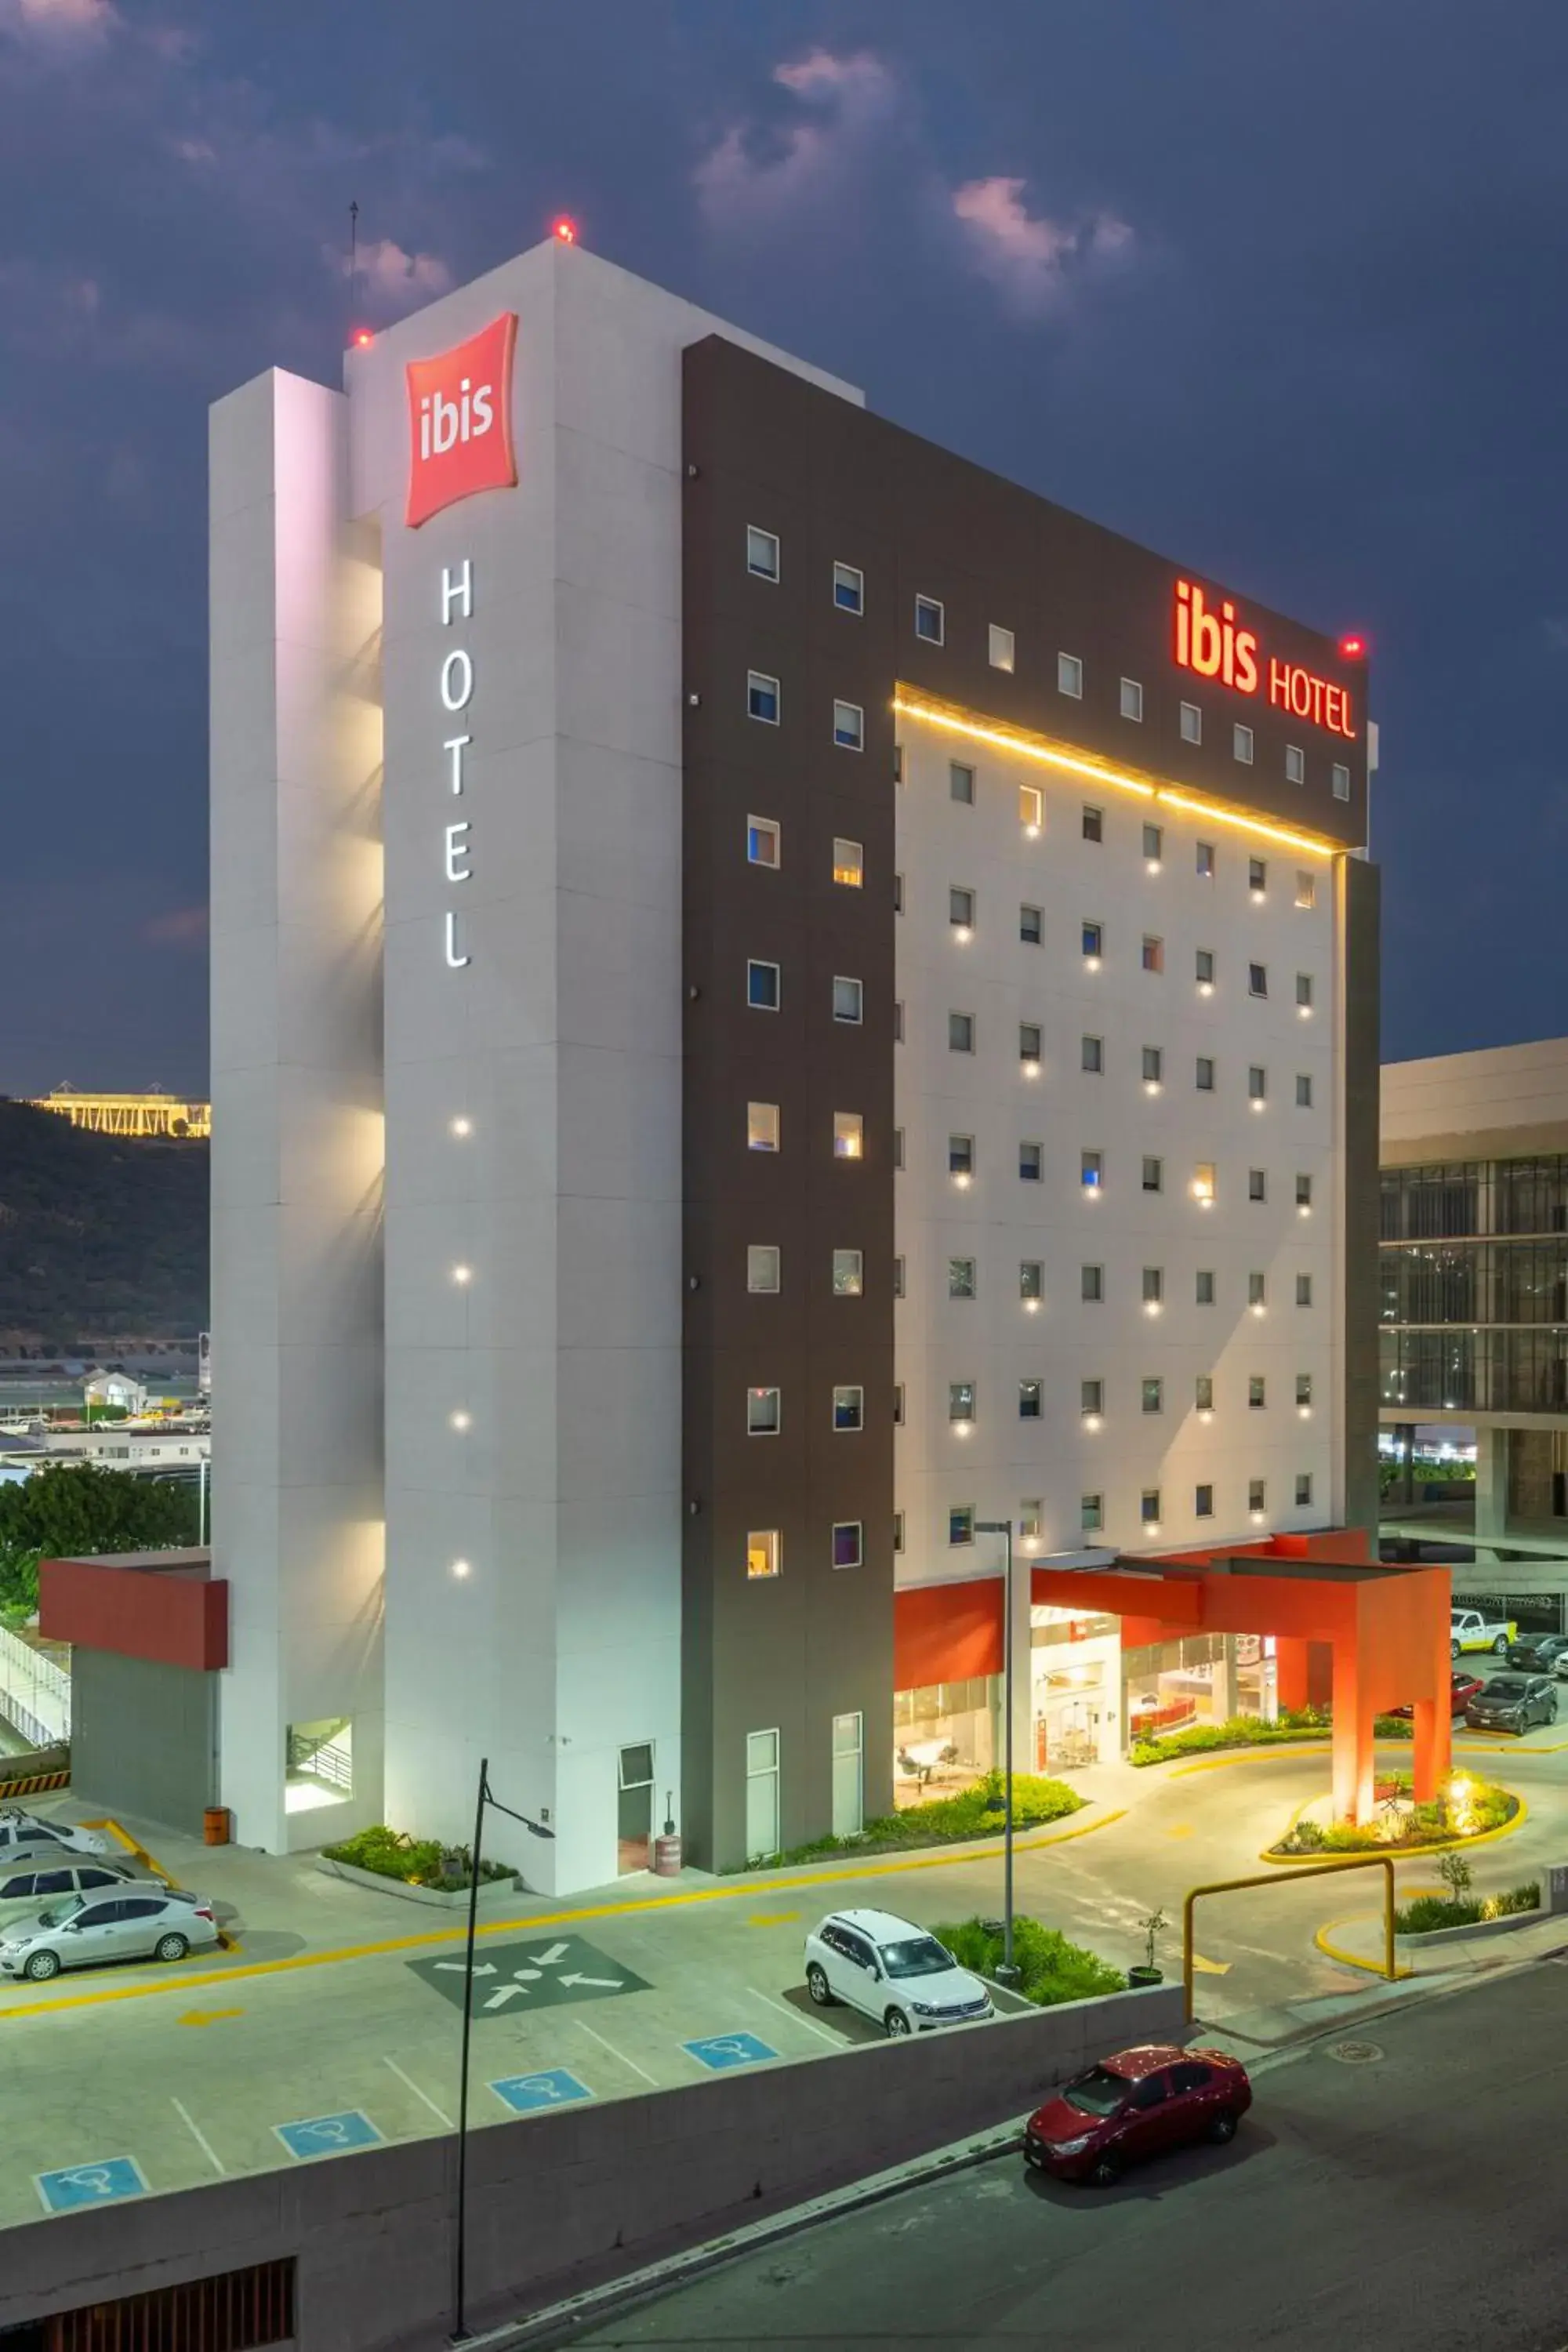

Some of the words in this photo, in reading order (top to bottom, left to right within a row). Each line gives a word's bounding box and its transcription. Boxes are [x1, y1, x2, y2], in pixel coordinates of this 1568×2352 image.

[421, 378, 493, 461] ibis
[1177, 579, 1258, 693] ibis
[1270, 657, 1356, 739] HOTEL
[441, 559, 473, 969] HOTEL
